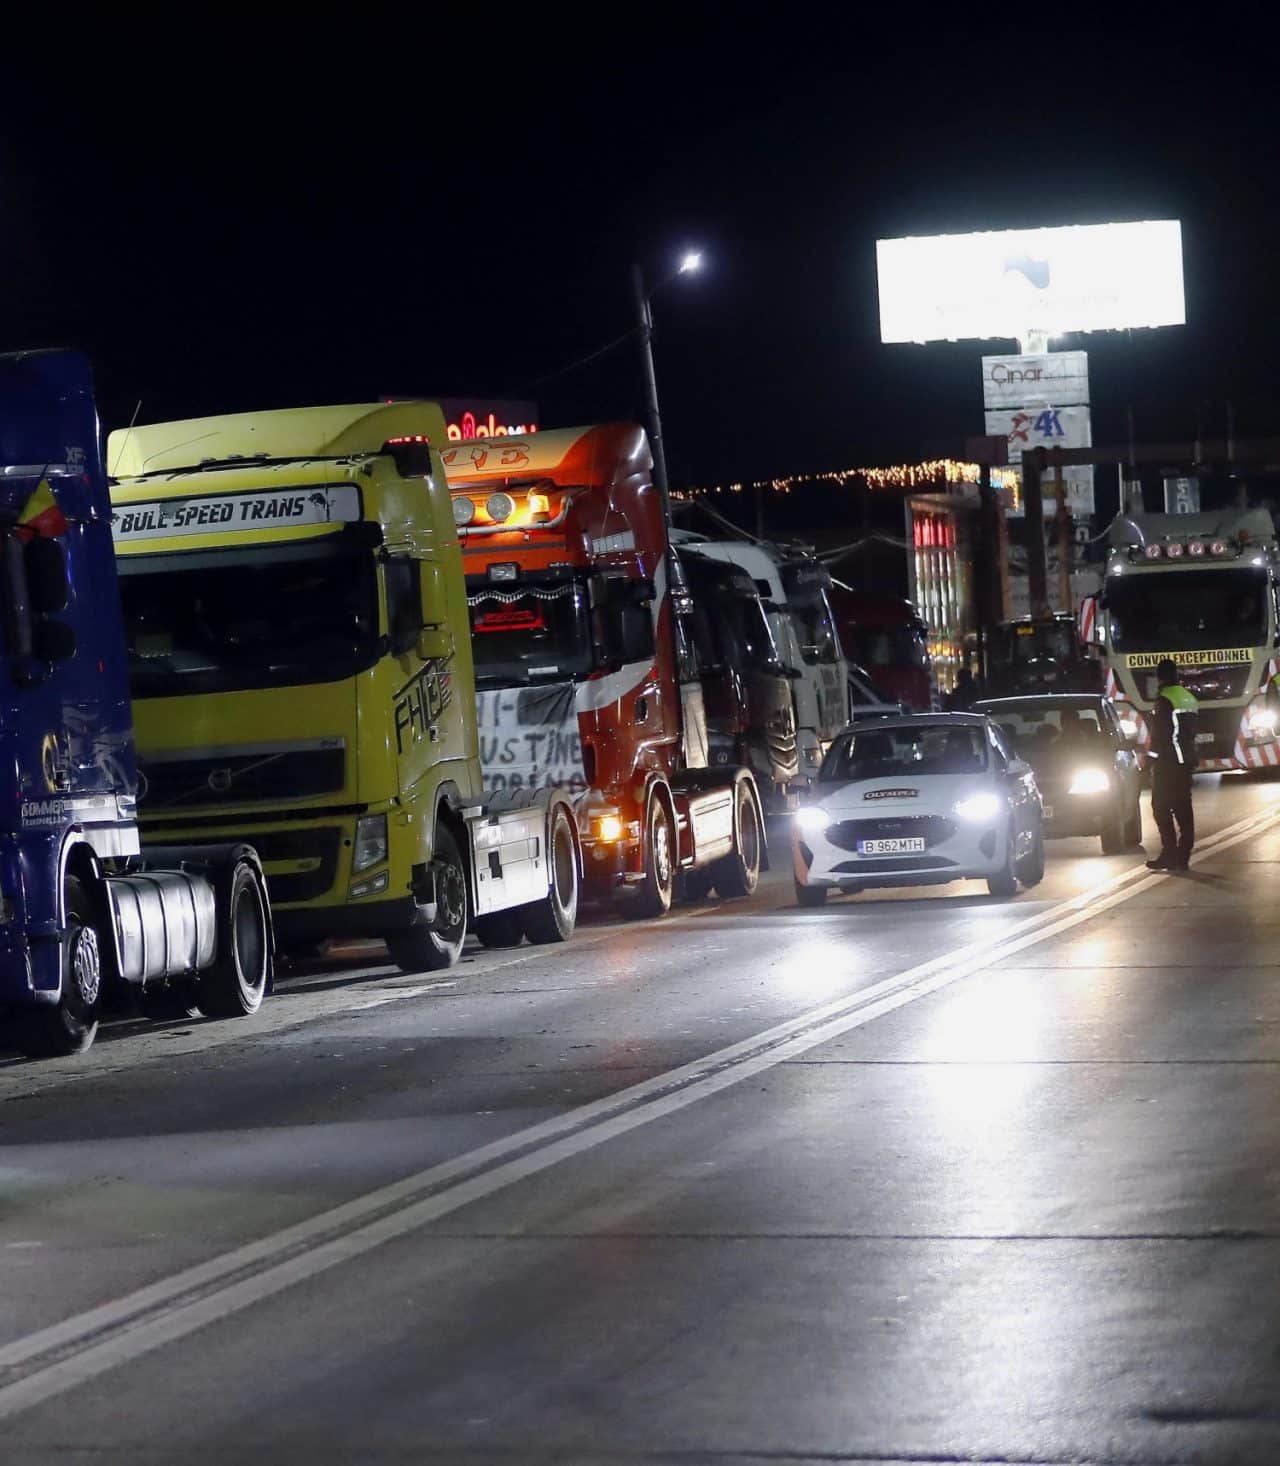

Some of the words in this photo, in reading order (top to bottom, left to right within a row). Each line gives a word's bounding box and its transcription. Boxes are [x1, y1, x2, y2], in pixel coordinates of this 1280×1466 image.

[120, 510, 168, 533] BULL
[173, 502, 234, 527] SPEED
[239, 497, 306, 520] TRANS
[1173, 649, 1251, 663] EXCEPTIONNEL
[865, 790, 917, 799] OLYMPIA
[865, 842, 874, 852] B
[877, 840, 898, 851] 962
[900, 839, 922, 850] MTH
